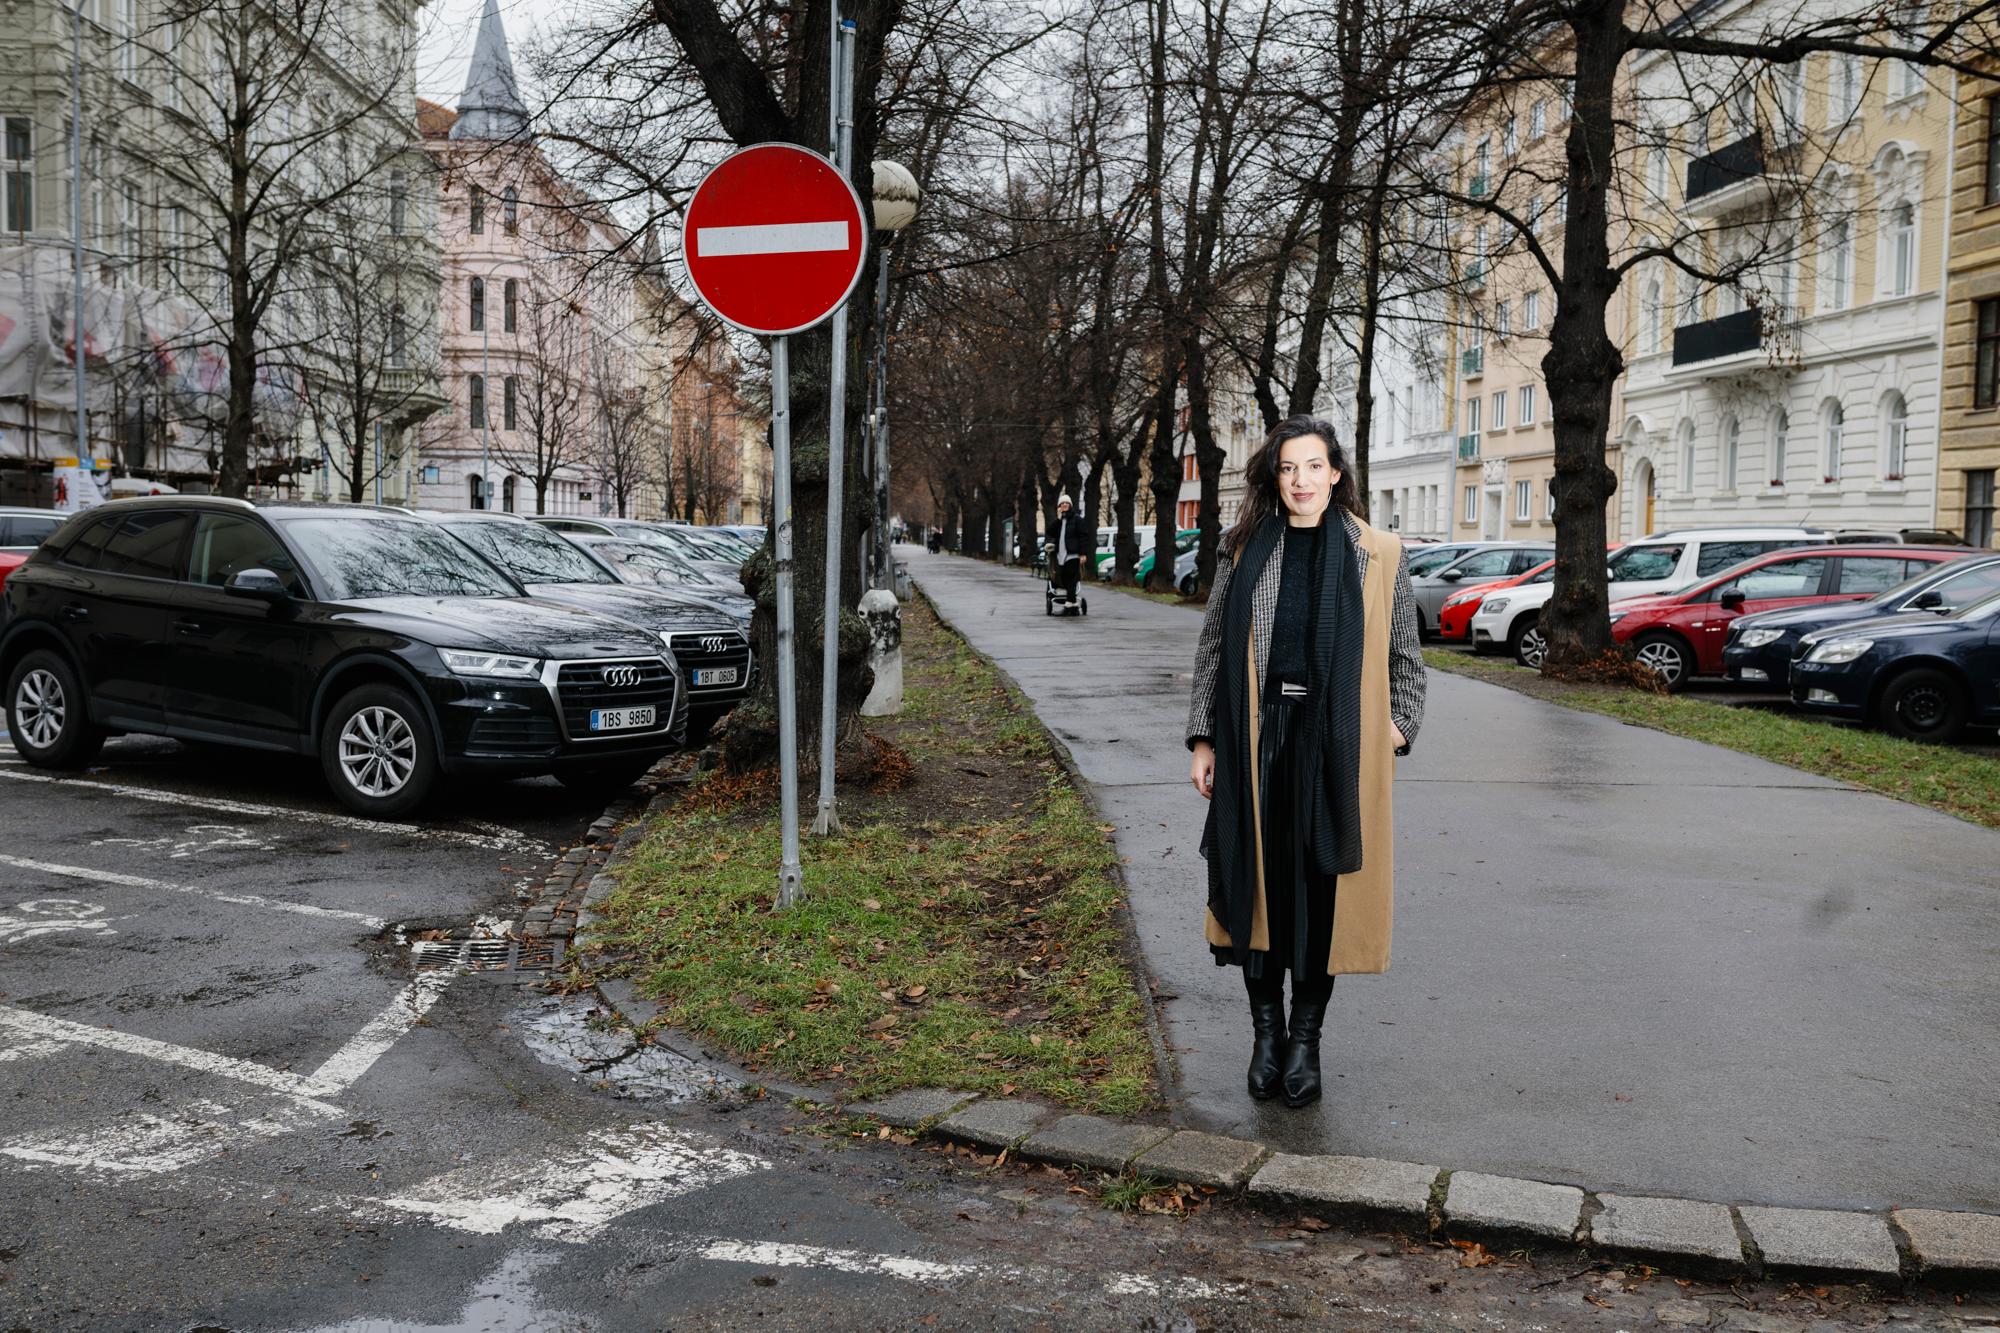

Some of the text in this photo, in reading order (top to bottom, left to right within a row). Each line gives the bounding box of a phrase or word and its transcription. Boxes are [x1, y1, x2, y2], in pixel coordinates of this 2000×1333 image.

[701, 671, 714, 684] 1BT
[602, 709, 652, 728] 1BS 9850
